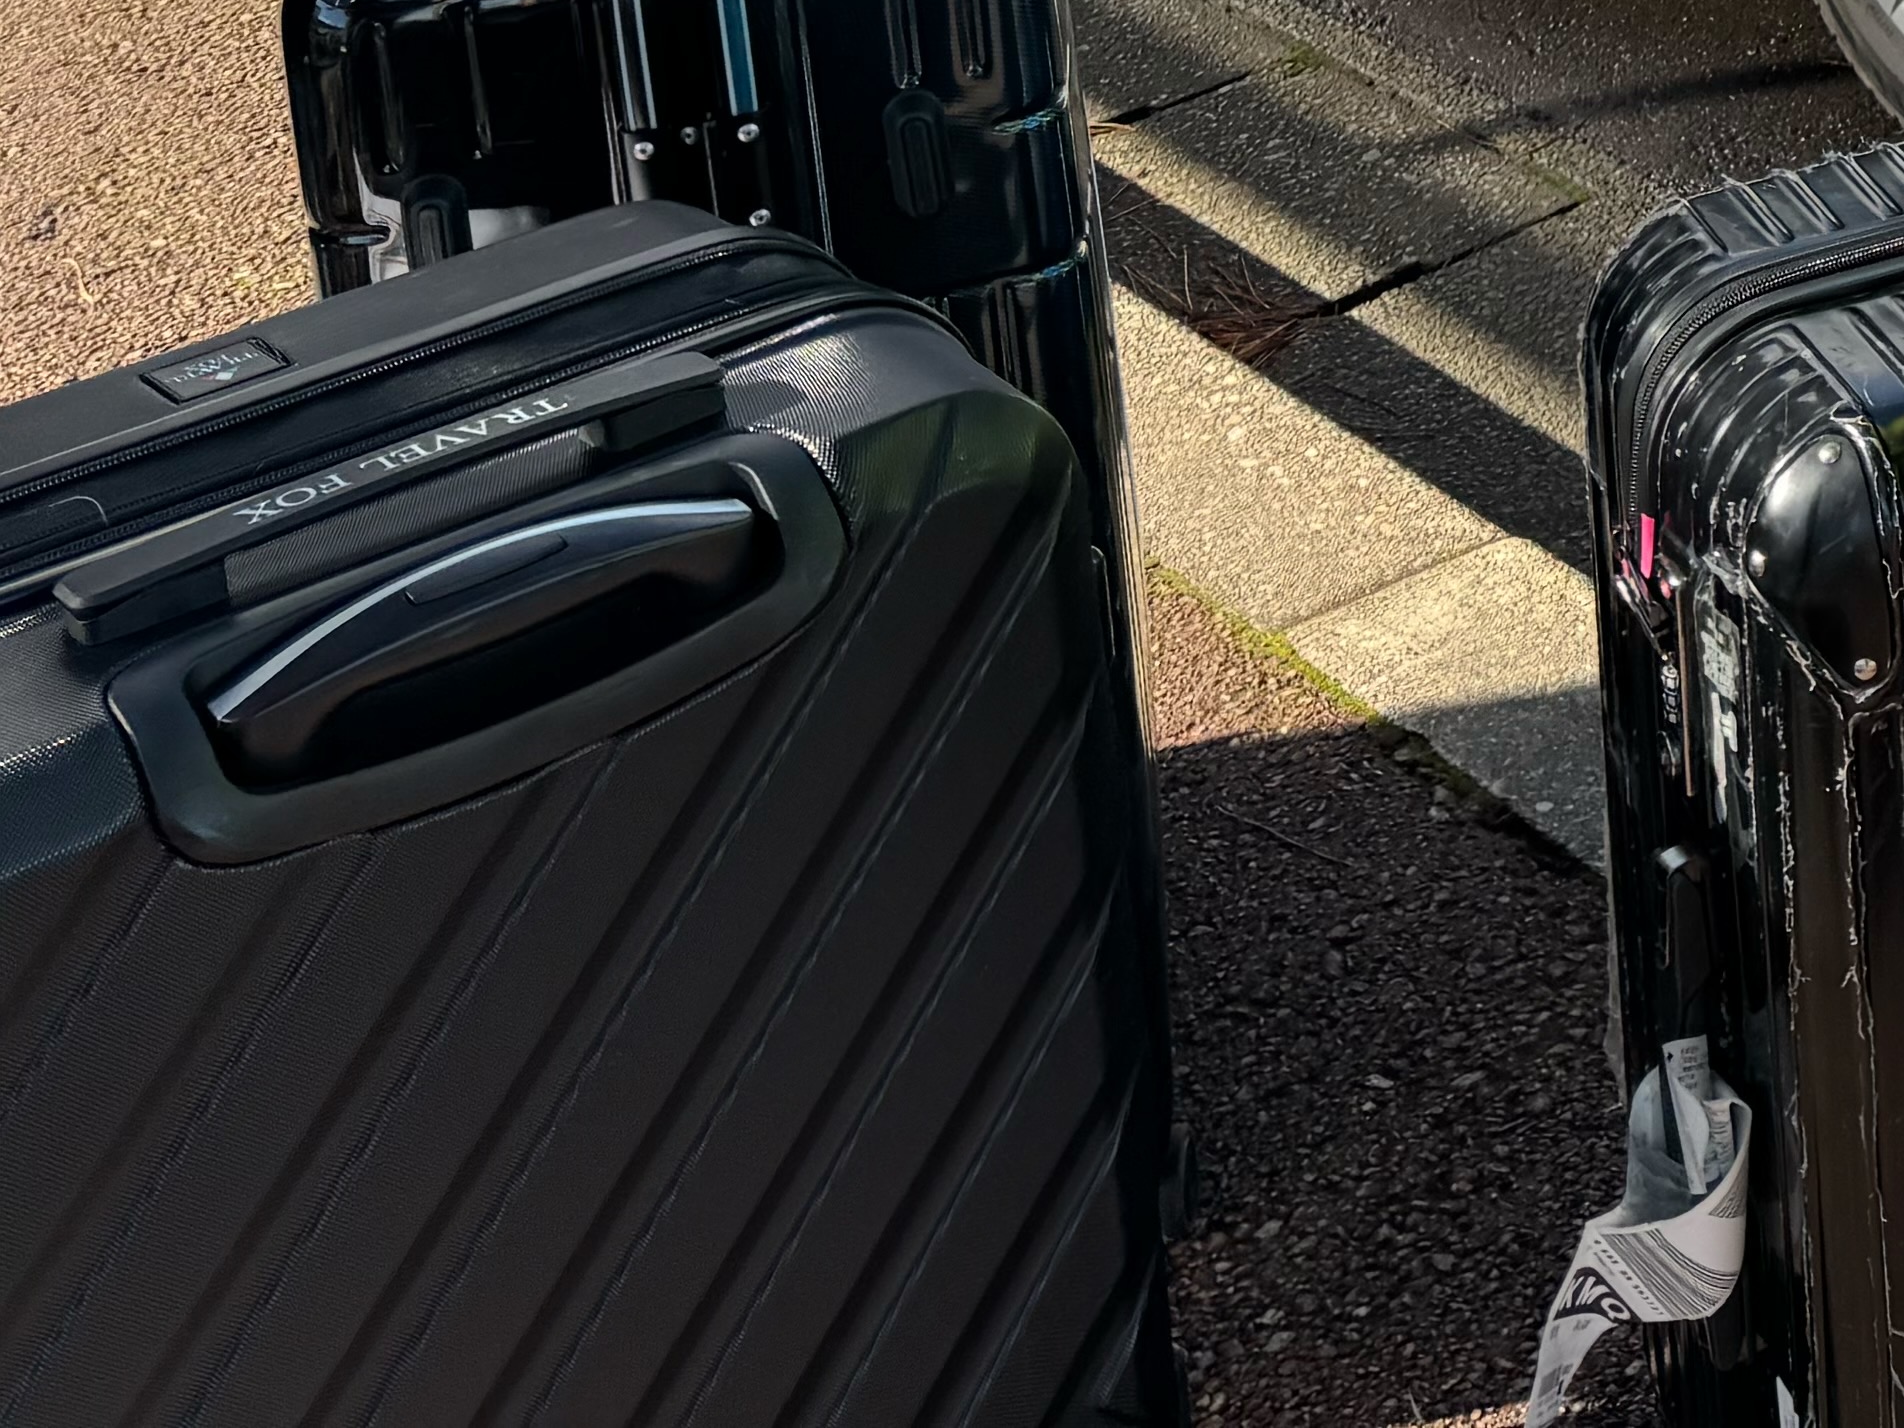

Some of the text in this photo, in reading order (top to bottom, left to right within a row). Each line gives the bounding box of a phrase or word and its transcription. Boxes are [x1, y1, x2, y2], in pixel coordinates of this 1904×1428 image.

[233, 396, 570, 526] TRAVEL FOX
[1558, 1274, 1631, 1323] KMQ
